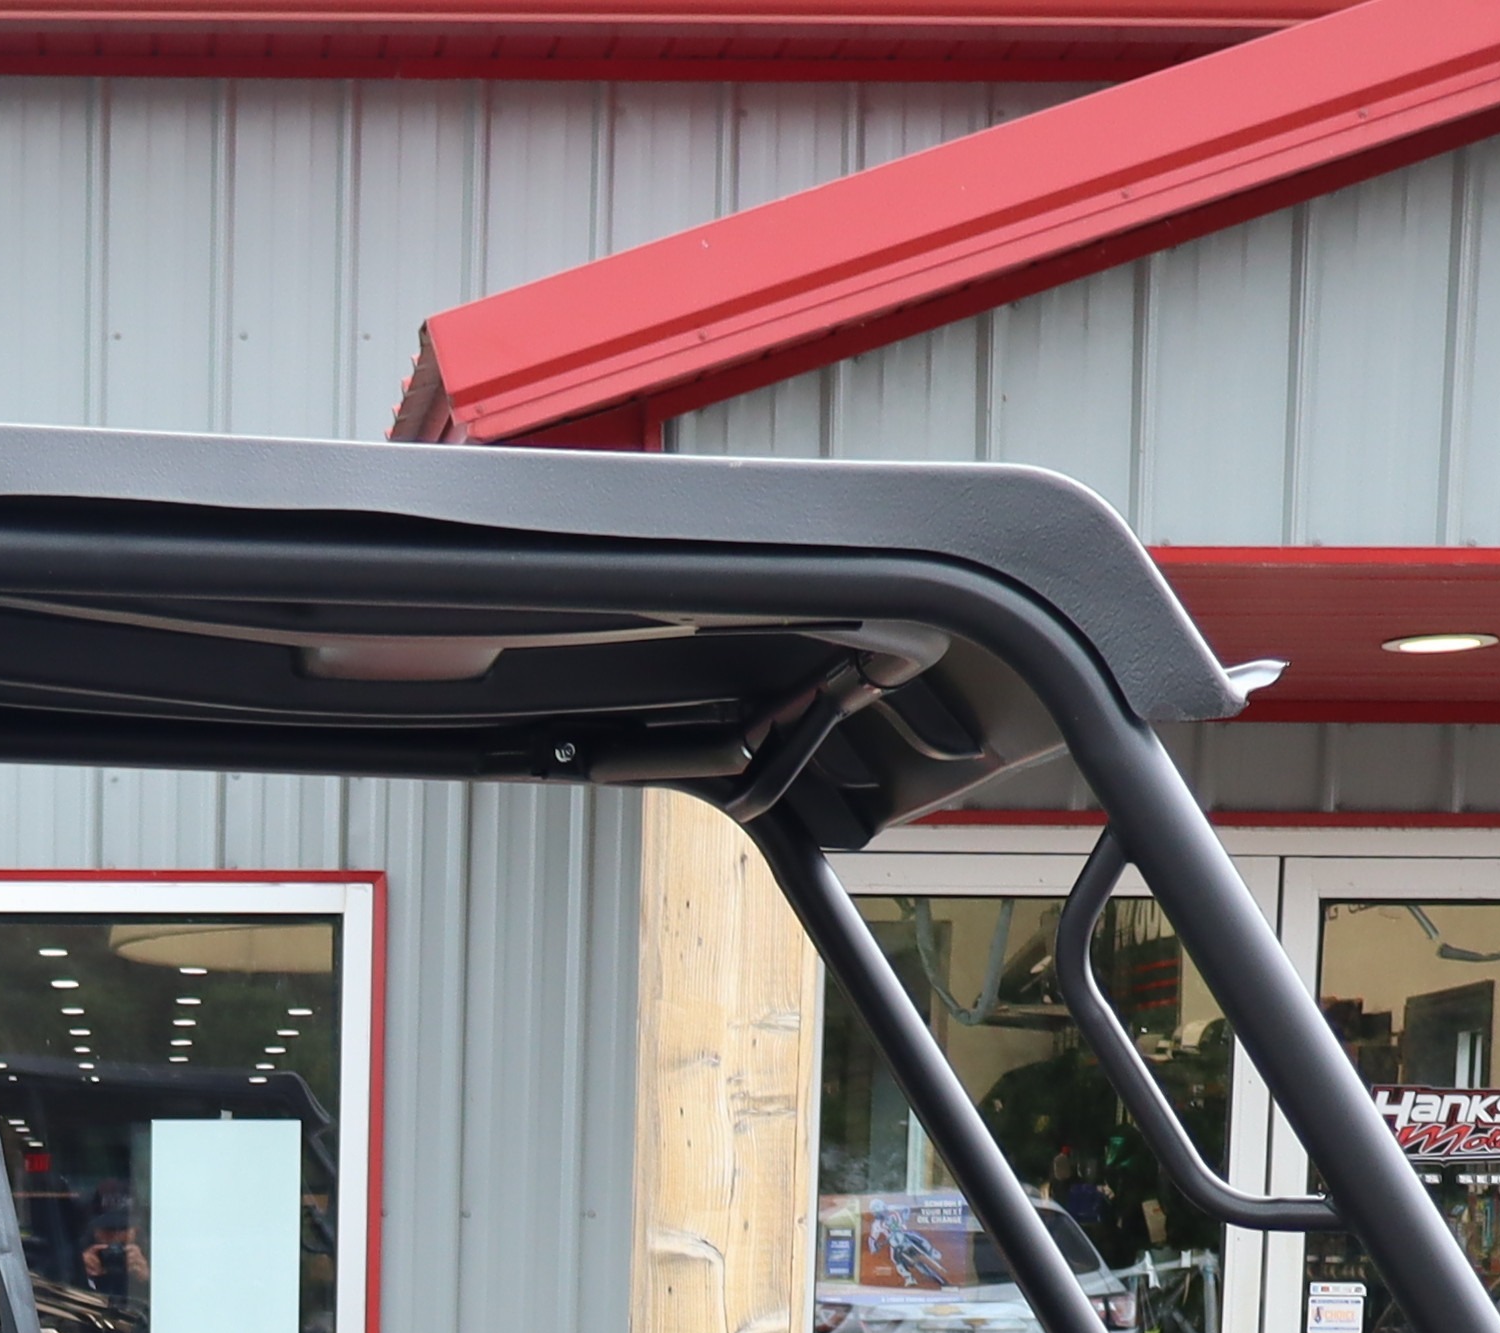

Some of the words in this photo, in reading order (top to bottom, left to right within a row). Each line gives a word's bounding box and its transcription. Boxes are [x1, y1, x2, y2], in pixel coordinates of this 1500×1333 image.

[920, 1208, 941, 1216] YOUR
[942, 1208, 963, 1216] NEXT
[917, 1216, 930, 1224] OIL
[931, 1216, 963, 1224] CHANGE
